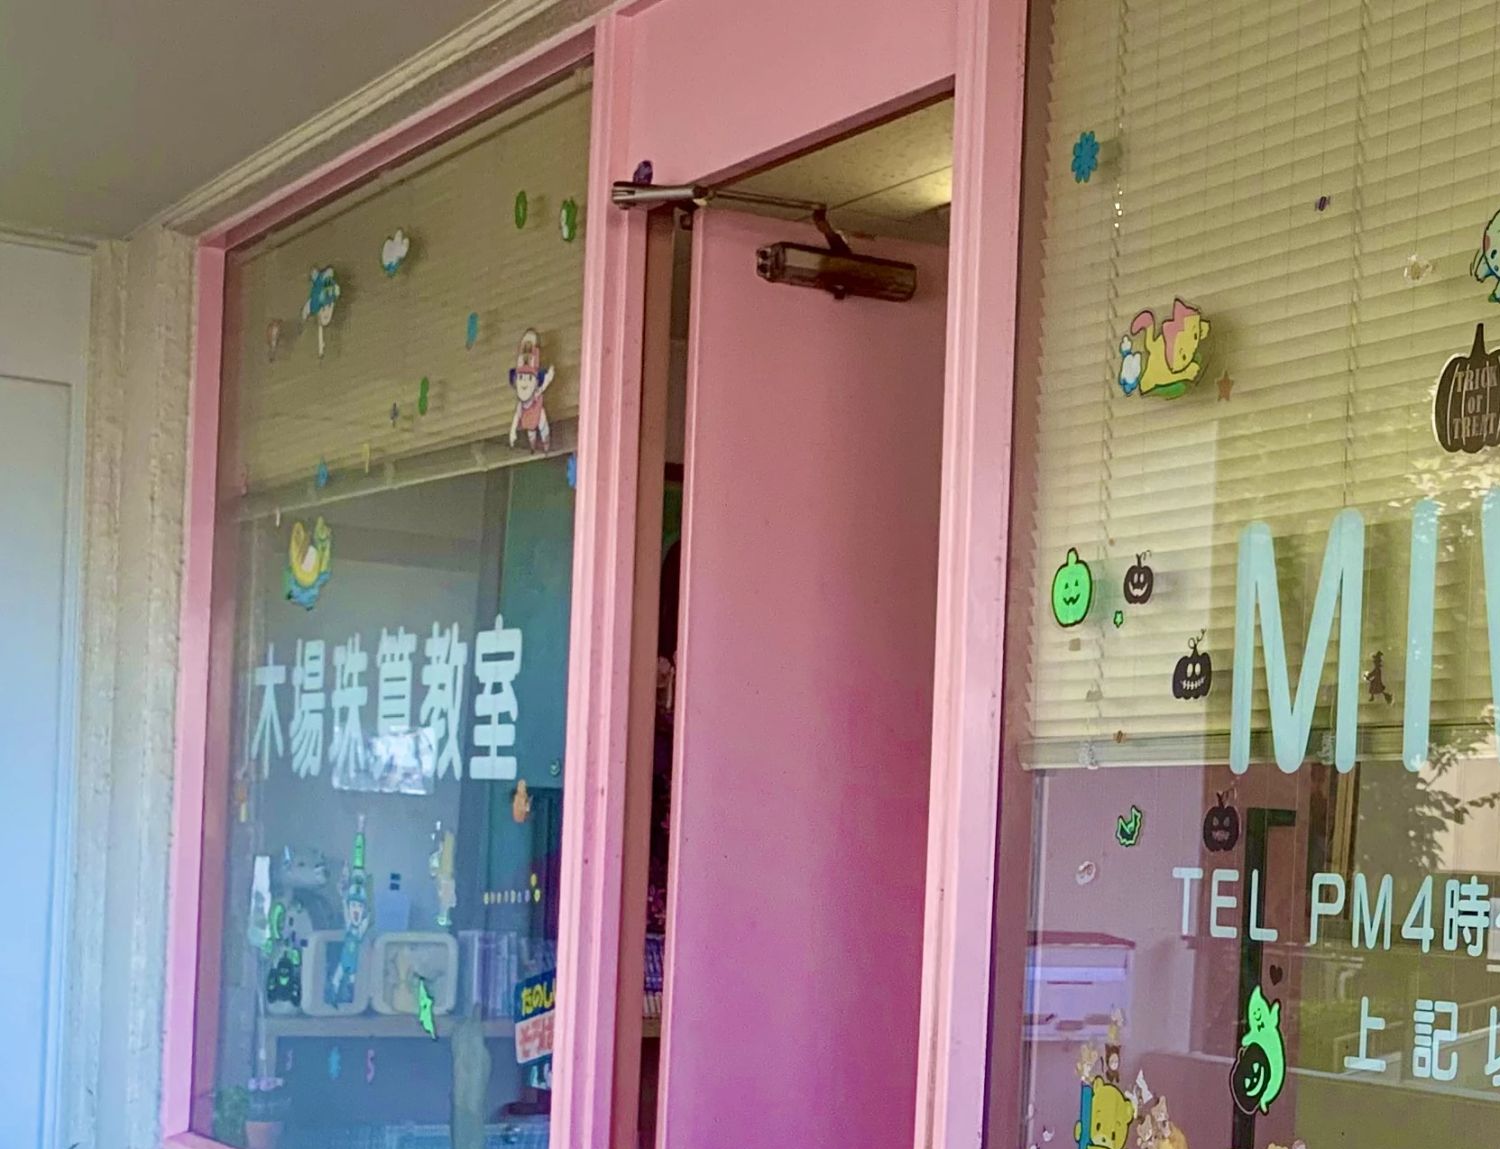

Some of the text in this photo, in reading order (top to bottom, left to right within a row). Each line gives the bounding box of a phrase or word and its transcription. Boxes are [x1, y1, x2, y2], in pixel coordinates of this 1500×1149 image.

[1455, 365, 1498, 392] TRICK
[1467, 394, 1483, 414] or
[1453, 412, 1497, 439] TREAT
[1173, 867, 1277, 942] TEL
